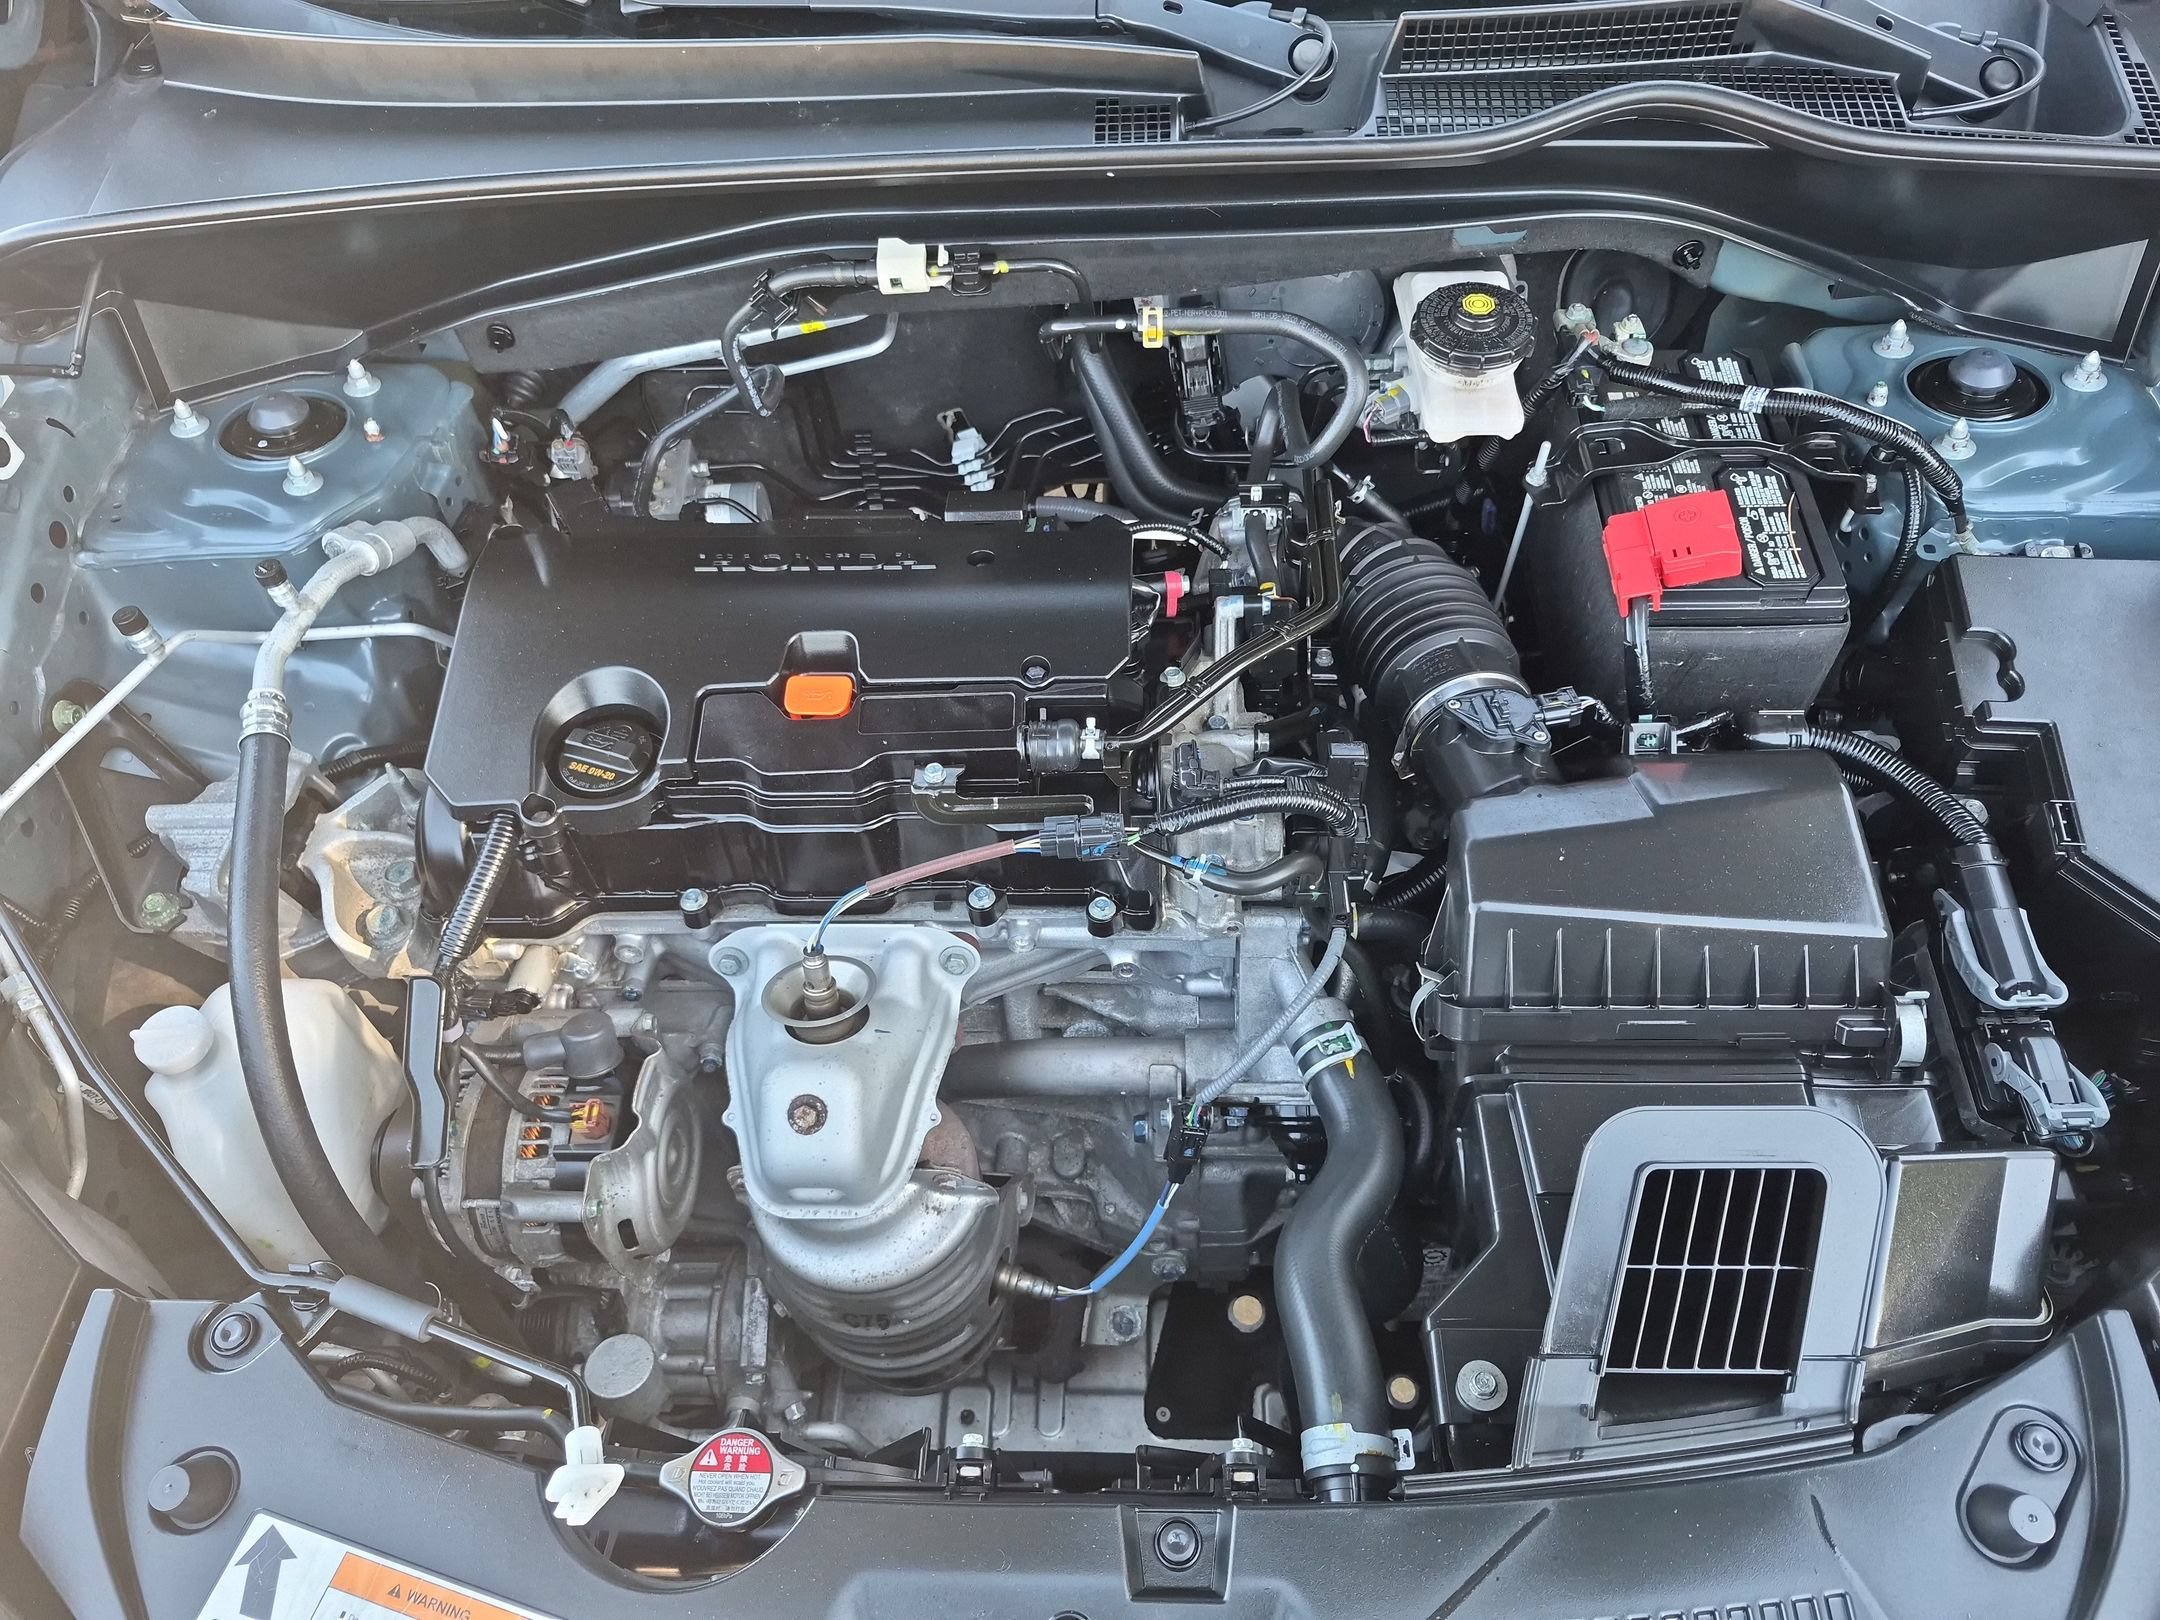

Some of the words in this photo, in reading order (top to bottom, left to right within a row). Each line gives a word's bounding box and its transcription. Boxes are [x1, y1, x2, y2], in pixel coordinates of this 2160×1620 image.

[568, 761, 589, 774] SAE
[587, 766, 616, 781] 0W-20
[720, 1438, 754, 1446] DANGER
[720, 1446, 761, 1455] WARNUNG
[406, 1588, 471, 1620] WARNING
